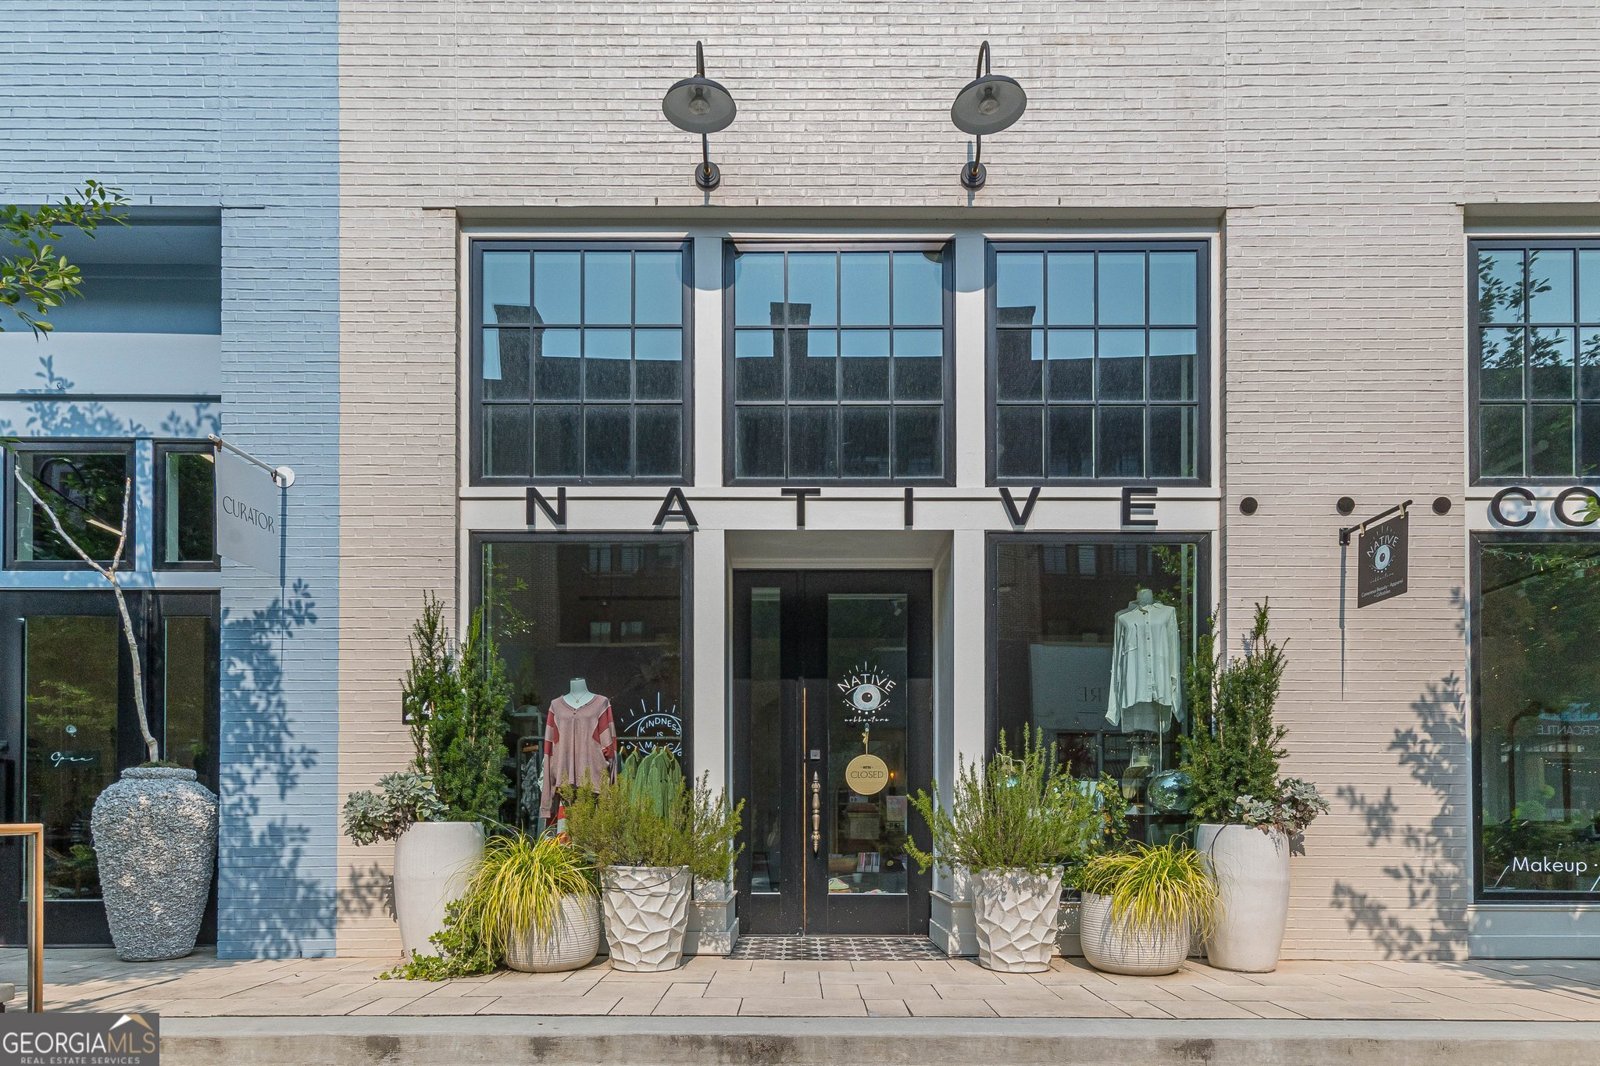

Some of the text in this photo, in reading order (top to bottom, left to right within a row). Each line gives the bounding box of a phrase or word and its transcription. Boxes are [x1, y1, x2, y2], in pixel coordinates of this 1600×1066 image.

[222, 495, 275, 534] CURATOR
[525, 486, 1159, 527] NATIVE
[1366, 534, 1399, 558] NATIVE
[837, 673, 897, 693] NATIVE
[639, 717, 681, 736] KINDNESS
[644, 741, 674, 752] MAC
[850, 770, 884, 779] CLOSED
[1511, 856, 1588, 876] Makeup
